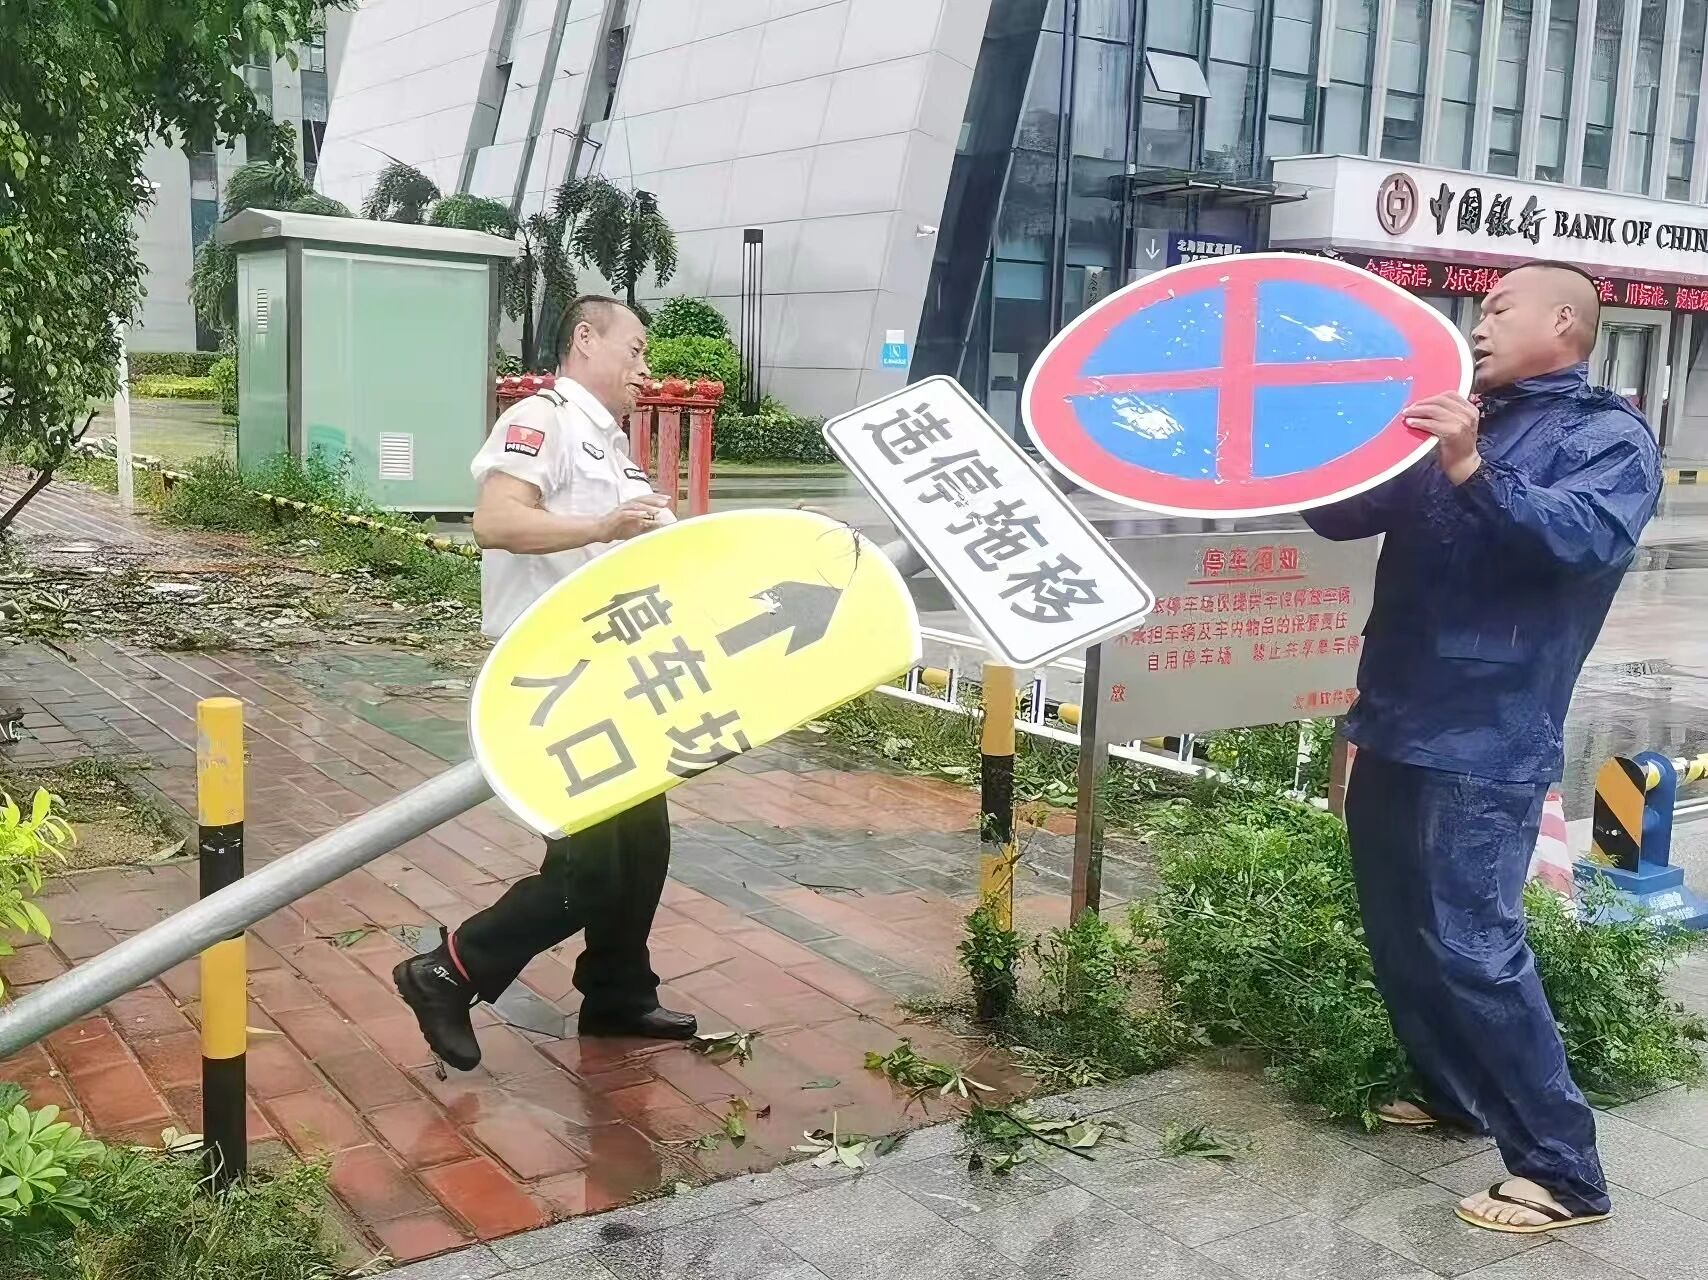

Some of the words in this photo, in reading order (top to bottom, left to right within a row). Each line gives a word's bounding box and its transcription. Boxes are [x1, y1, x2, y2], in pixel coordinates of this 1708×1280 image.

[1553, 209, 1617, 244] BANK
[1621, 218, 1653, 247] OF
[861, 402, 1105, 624] 违停拖移
[1202, 546, 1298, 577] 停车须知
[581, 583, 753, 779] 停车场
[1148, 646, 1233, 672] 自用停车场
[510, 658, 638, 799] 入口
